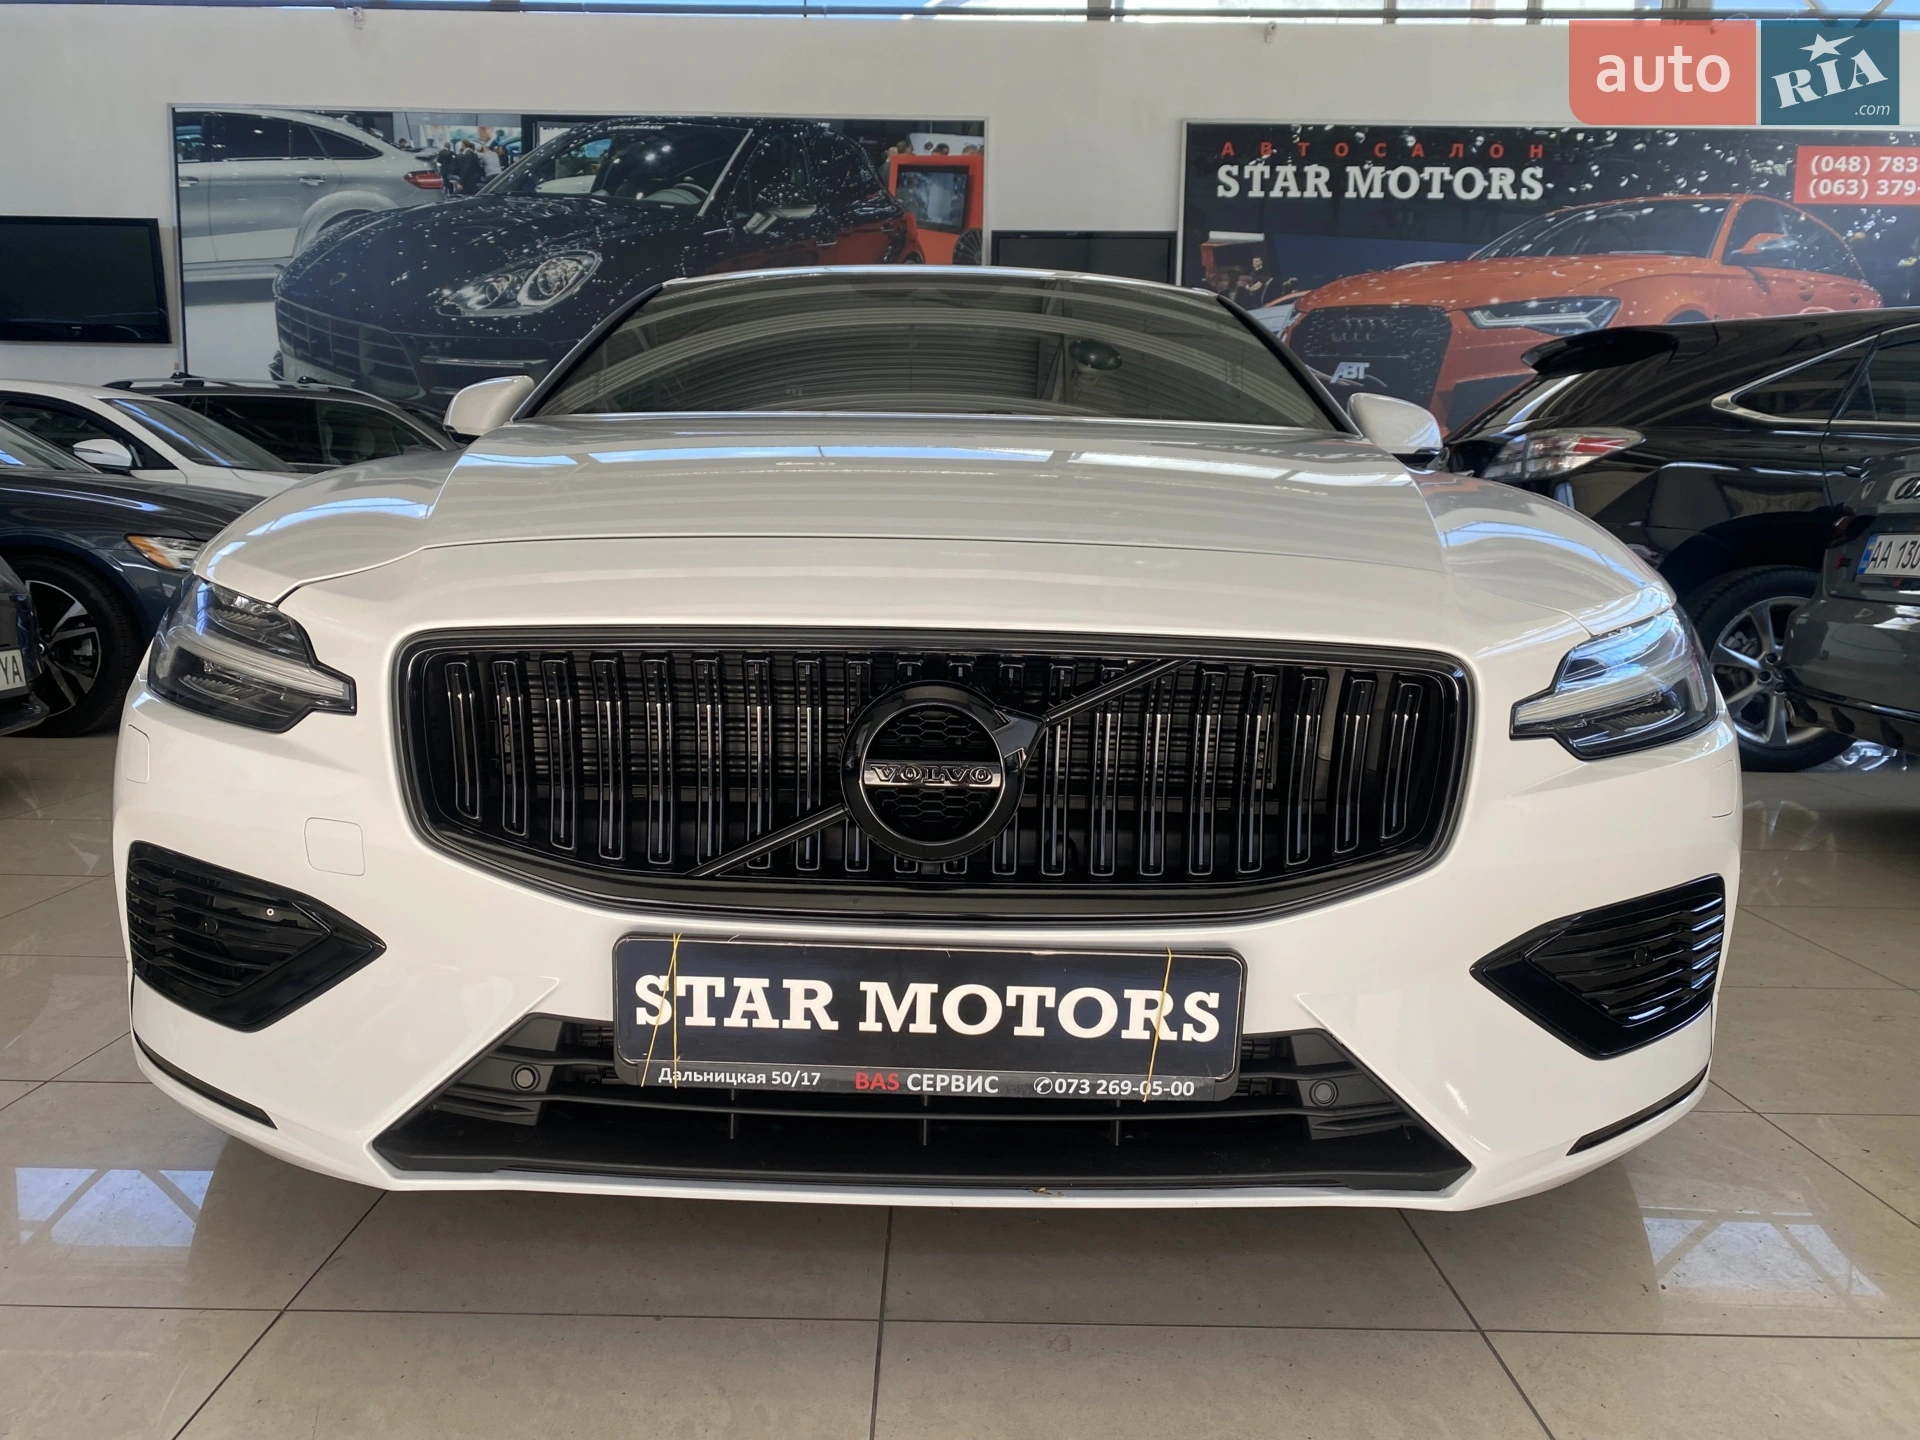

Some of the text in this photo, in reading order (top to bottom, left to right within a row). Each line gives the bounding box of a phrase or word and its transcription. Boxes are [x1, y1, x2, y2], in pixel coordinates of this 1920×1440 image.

[1810, 154, 1871, 176] (048)
[1217, 164, 1544, 200] STAR MOTORS
[1808, 177, 1869, 199] (063)
[1329, 361, 1370, 384] ABT
[1868, 540, 1894, 569] AA
[870, 764, 993, 784] VOLVO
[635, 974, 1220, 1043] STAR MOTORS
[658, 1067, 822, 1087] Дальницкая 50/17
[855, 1072, 999, 1093] BAS СЕРВИС
[1055, 1078, 1195, 1096] 073 269-05-00
